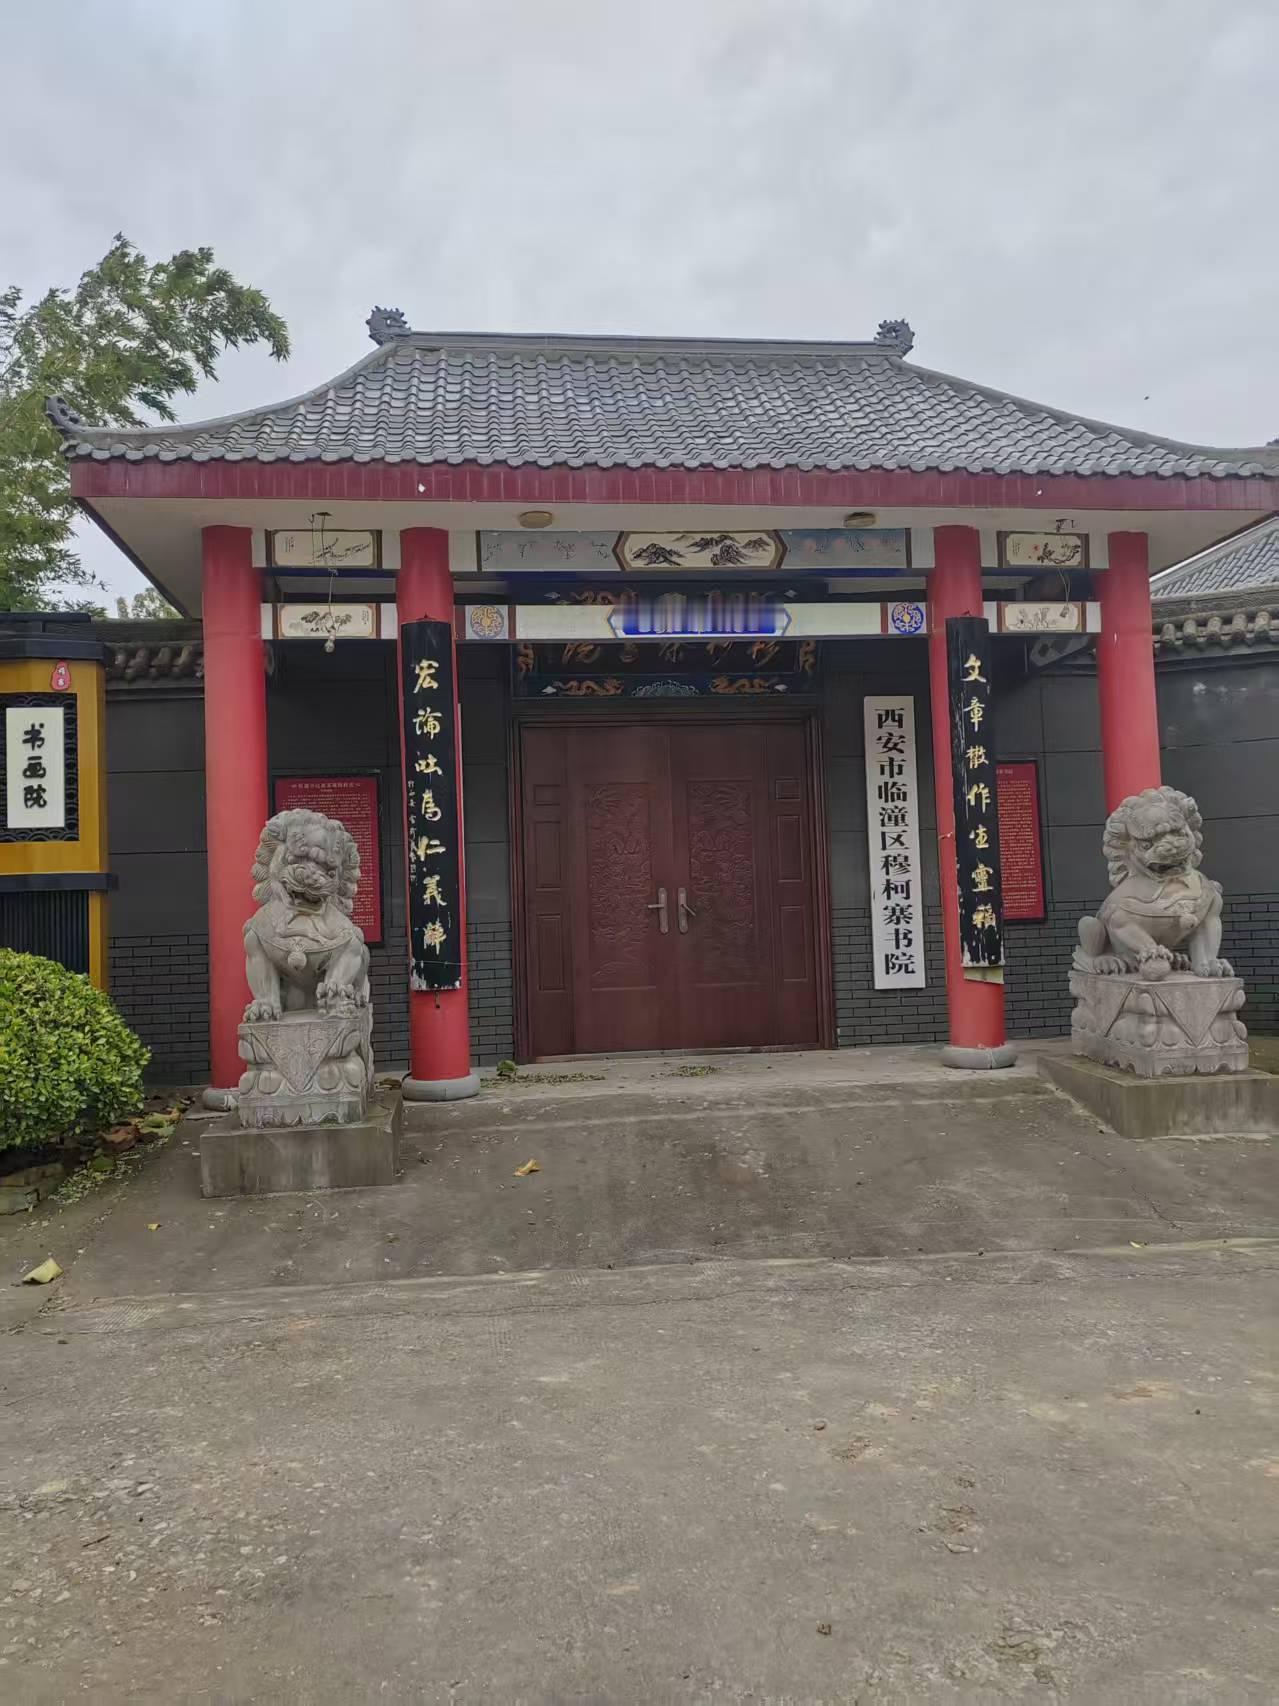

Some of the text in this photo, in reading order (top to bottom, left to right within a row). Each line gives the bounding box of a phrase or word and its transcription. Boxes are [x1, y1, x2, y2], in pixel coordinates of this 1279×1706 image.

[22, 723, 47, 808] 书画院
[875, 707, 916, 976] 西安市临潼区穆柯寨书院
